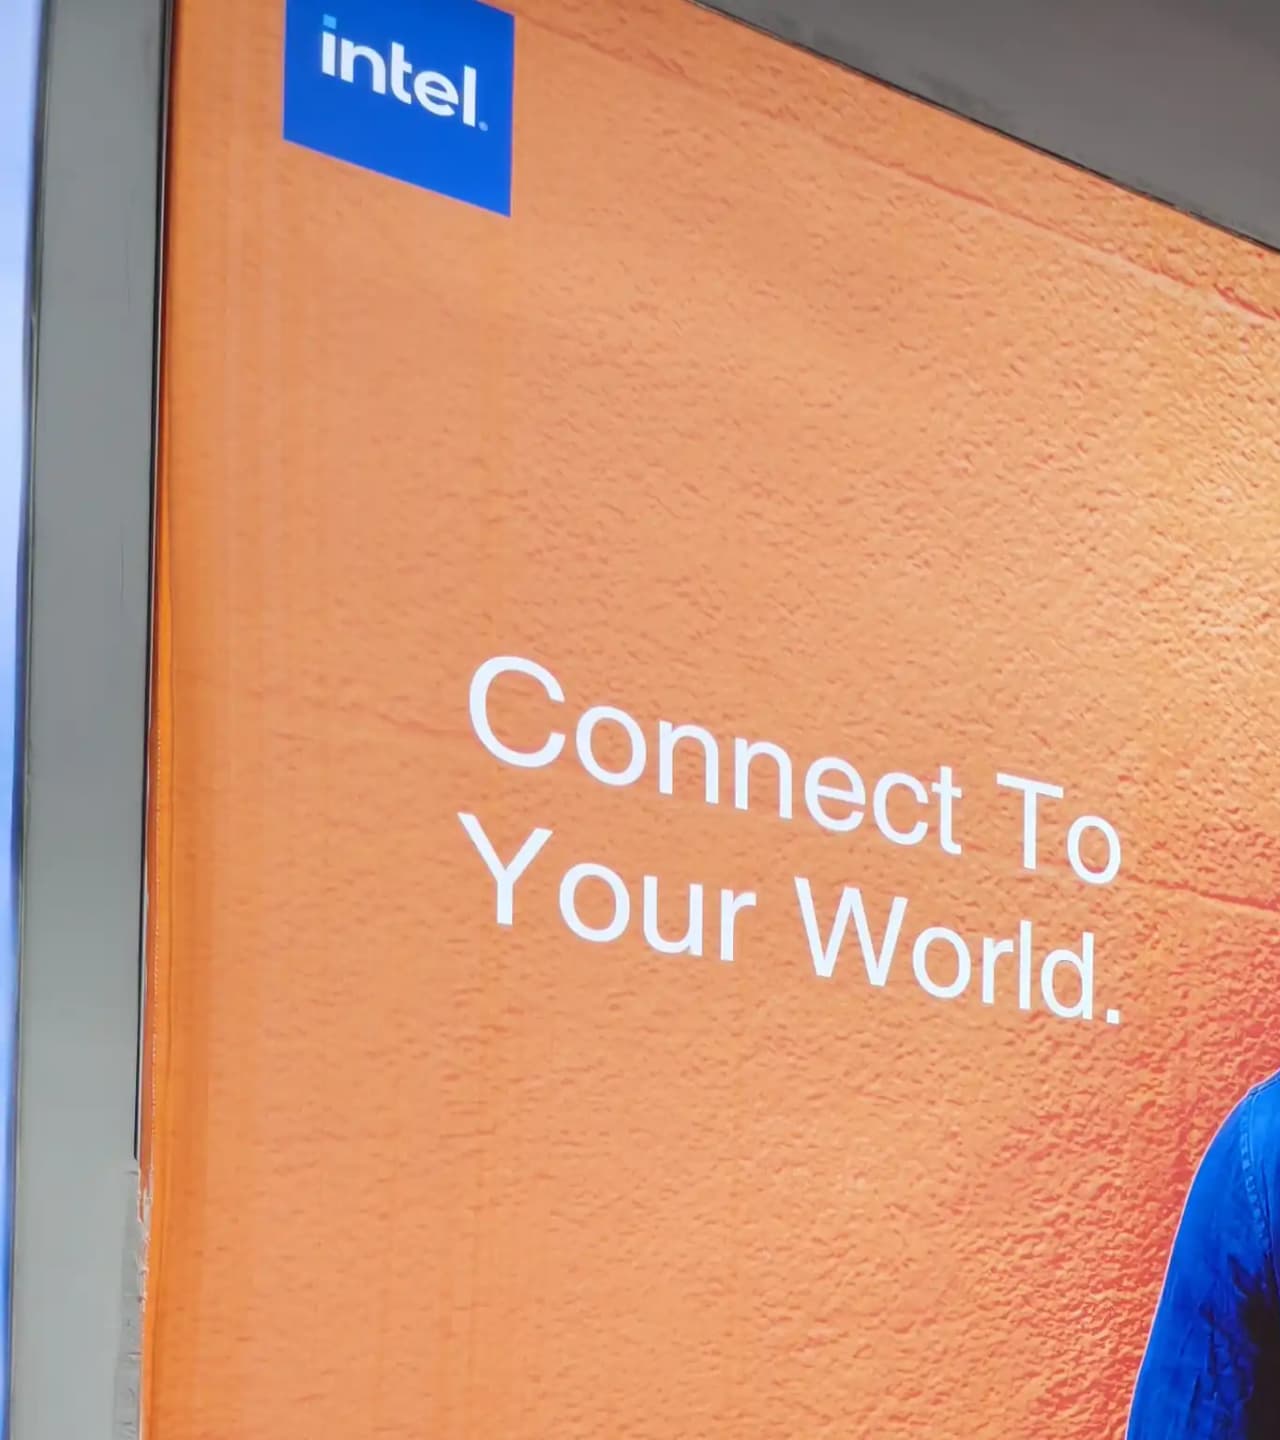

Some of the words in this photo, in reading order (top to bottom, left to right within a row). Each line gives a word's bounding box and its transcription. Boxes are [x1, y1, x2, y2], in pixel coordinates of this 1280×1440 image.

[469, 655, 963, 855] Connect
[997, 773, 1122, 885] To
[458, 811, 757, 962] Your
[795, 876, 1122, 1025] World.
